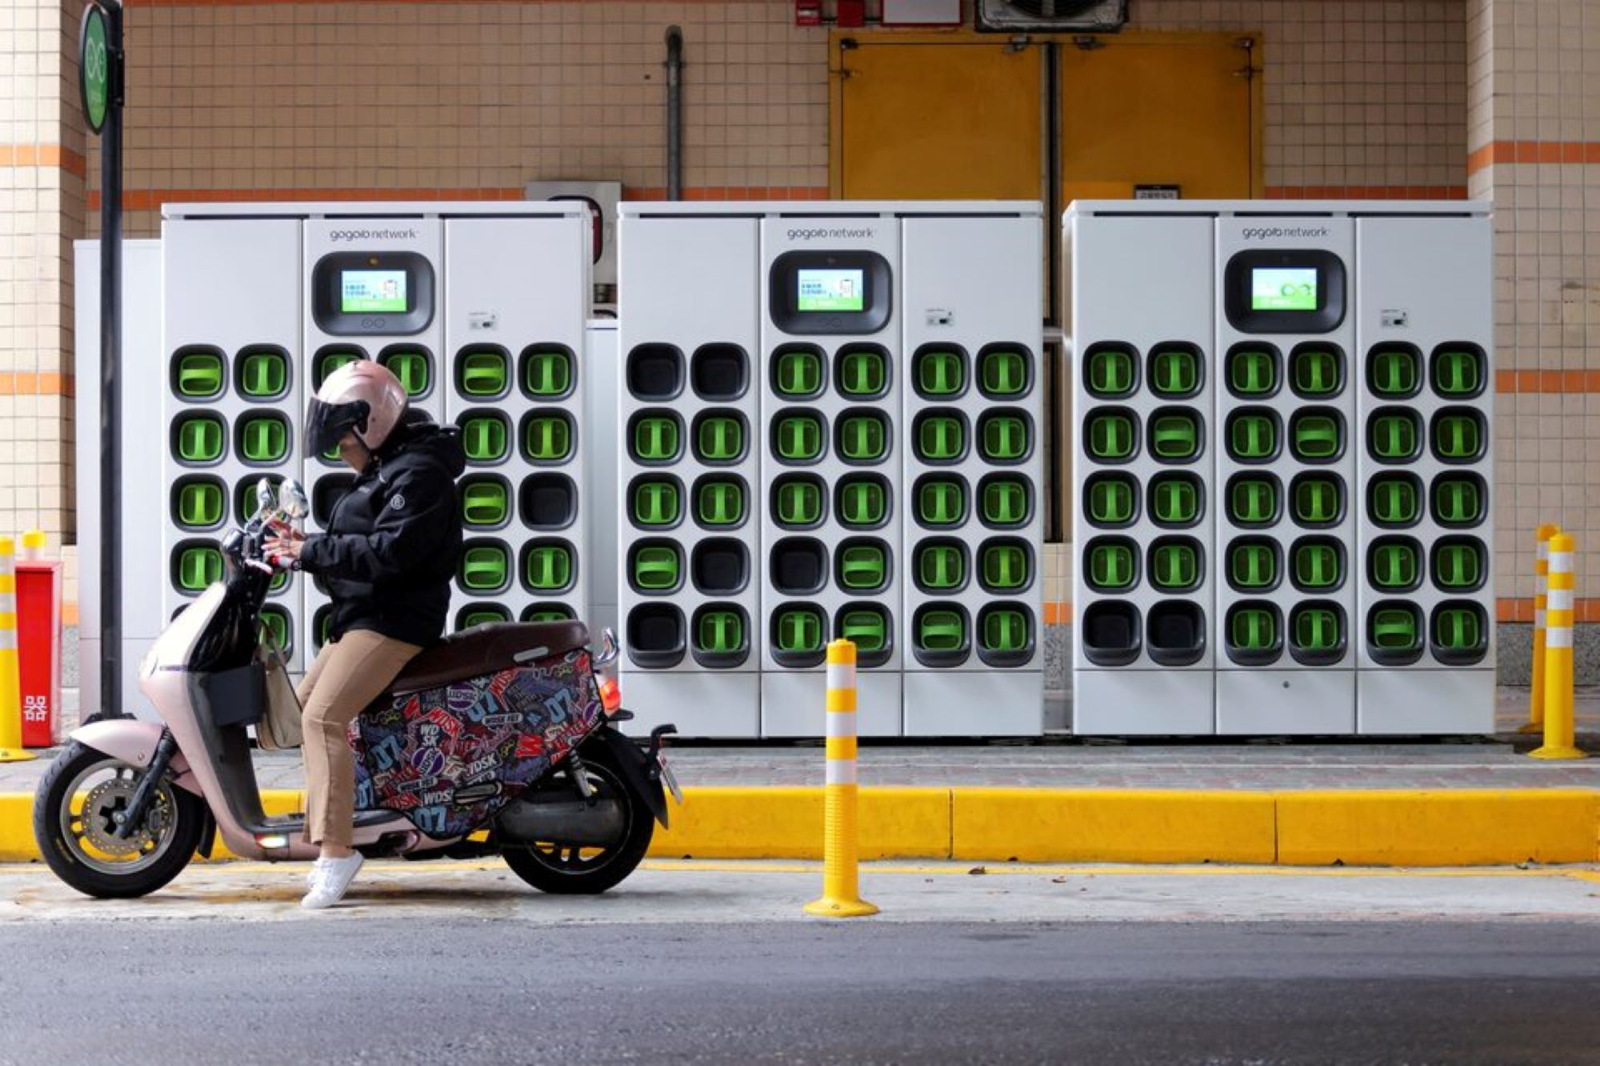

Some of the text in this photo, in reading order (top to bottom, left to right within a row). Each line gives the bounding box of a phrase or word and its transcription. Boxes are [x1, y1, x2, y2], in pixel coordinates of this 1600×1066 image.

[371, 228, 418, 239] network
[829, 227, 874, 239] network
[1284, 226, 1329, 238] network
[370, 735, 402, 770] 07
[414, 804, 447, 833] 07
